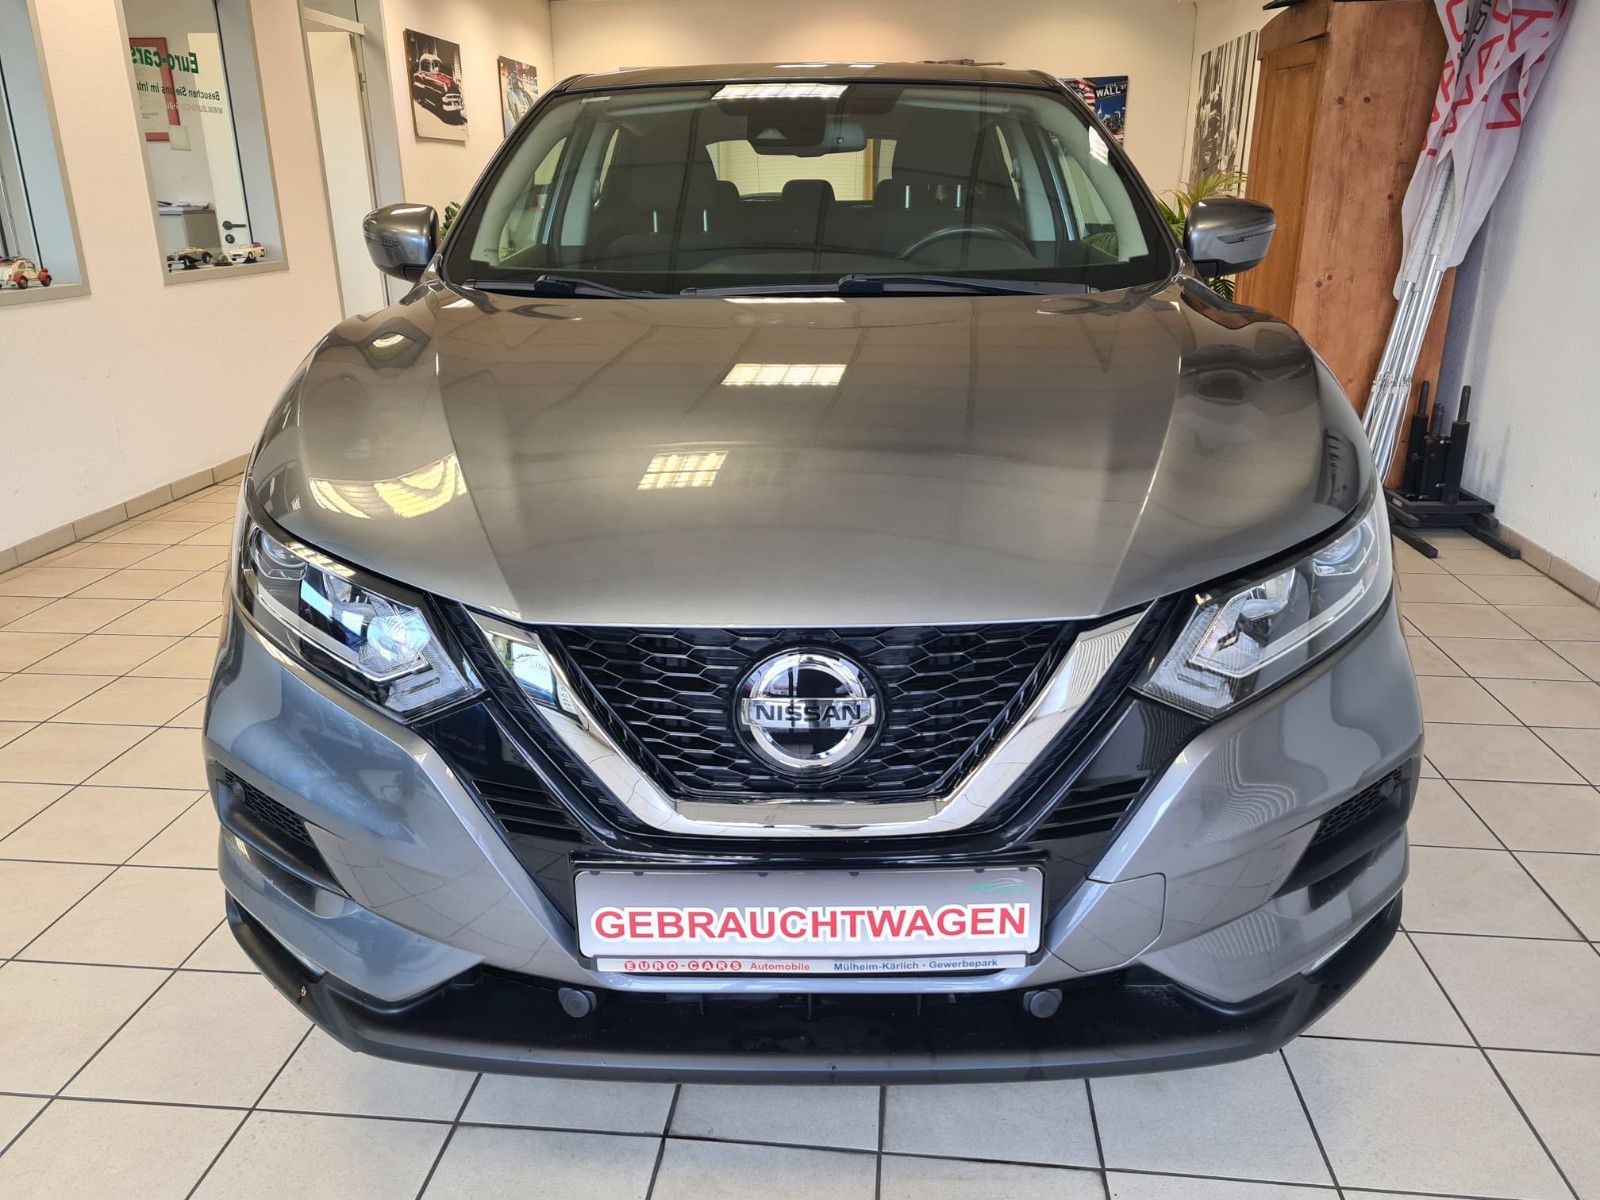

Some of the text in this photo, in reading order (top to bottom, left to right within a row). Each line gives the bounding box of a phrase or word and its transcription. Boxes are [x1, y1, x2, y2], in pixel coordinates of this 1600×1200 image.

[1096, 86, 1121, 98] WALL
[756, 704, 861, 721] NISSAN
[595, 907, 1025, 939] GEBRAUCHTWAGEN
[624, 958, 998, 973] EURO-CARS Automobile Mülheim-Kärlich Gewerbepark
